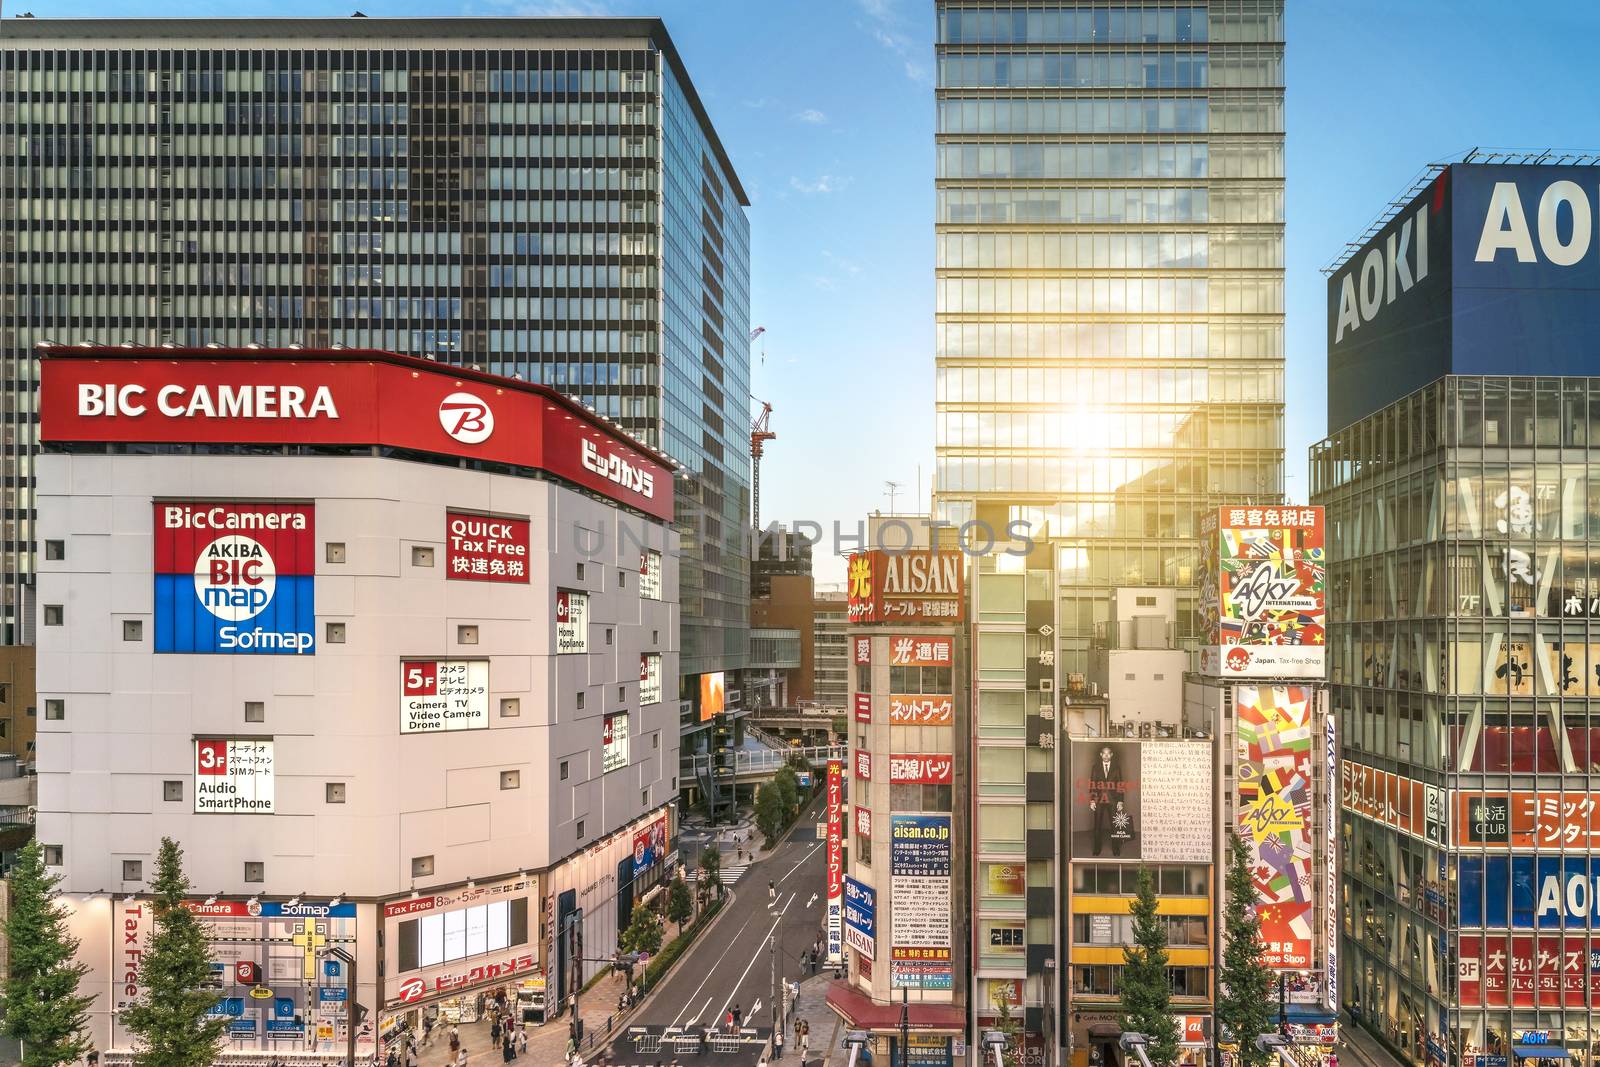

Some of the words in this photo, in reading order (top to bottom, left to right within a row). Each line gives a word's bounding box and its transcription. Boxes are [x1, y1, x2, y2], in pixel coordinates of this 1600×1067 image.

[1475, 180, 1600, 267] AO
[1335, 203, 1429, 345] AOKI
[78, 384, 147, 417] BIC
[156, 385, 340, 419] CAMERA
[581, 437, 654, 499] ビックカメラ
[1536, 485, 1557, 499] 7F
[1229, 509, 1316, 527] 愛客免税店
[451, 519, 513, 541] QUICK
[207, 543, 263, 558] AKIBA
[451, 536, 483, 554] Tax
[487, 539, 526, 557] Free
[209, 560, 264, 585] BIC
[452, 555, 525, 578] 快速免税
[883, 555, 959, 593] AISAN
[850, 557, 872, 599] 光
[204, 588, 268, 614] map
[557, 598, 569, 617] 6F
[1459, 595, 1480, 610] 7F
[219, 626, 314, 654] Sofmap
[558, 627, 575, 638] Home
[558, 638, 585, 652] Appliance
[892, 637, 949, 665] 光通信
[439, 665, 466, 674] カメラ
[1279, 656, 1303, 666] Tax-free
[1305, 656, 1321, 669] Shop
[407, 668, 434, 689] 5F
[439, 676, 466, 685] テレビ
[439, 687, 485, 696] ビデオカメラ
[1038, 650, 1055, 749] 坂口電熱
[409, 701, 448, 710] Camera
[454, 699, 469, 708] TV
[409, 711, 441, 720] Video
[442, 709, 482, 719] Camera
[890, 700, 952, 721] ネットワーク
[409, 720, 441, 729] Drone
[199, 747, 225, 769] 3F
[229, 744, 267, 753] オーディオ
[229, 756, 273, 765] スマートフォン
[890, 758, 951, 780] 配線パーツ
[229, 767, 271, 776] SIMカード
[198, 782, 237, 795] Audio
[198, 797, 272, 809] SmartPhone
[1524, 797, 1595, 818] コミック
[1248, 797, 1291, 832] AKKY
[1474, 805, 1506, 822] 快活
[828, 763, 842, 894] 光・ケーブル・ネットワーク
[894, 825, 949, 840] aisan.co.jp
[1475, 824, 1507, 835] CLUB
[1327, 837, 1338, 905] Tax-free
[1538, 874, 1600, 918] AO
[280, 904, 331, 918] Sofmap
[388, 904, 407, 915] Tax
[409, 900, 433, 911] Free
[125, 906, 142, 945] Tax
[1327, 907, 1338, 948] Shop
[846, 928, 873, 955] AISAN
[1284, 954, 1306, 965] Shop
[1459, 962, 1477, 977] 3F
[125, 949, 142, 997] Free
[436, 954, 533, 991] ビックカメラ
[1522, 1032, 1550, 1044] AOKI
[1464, 1057, 1474, 1067] 3F
